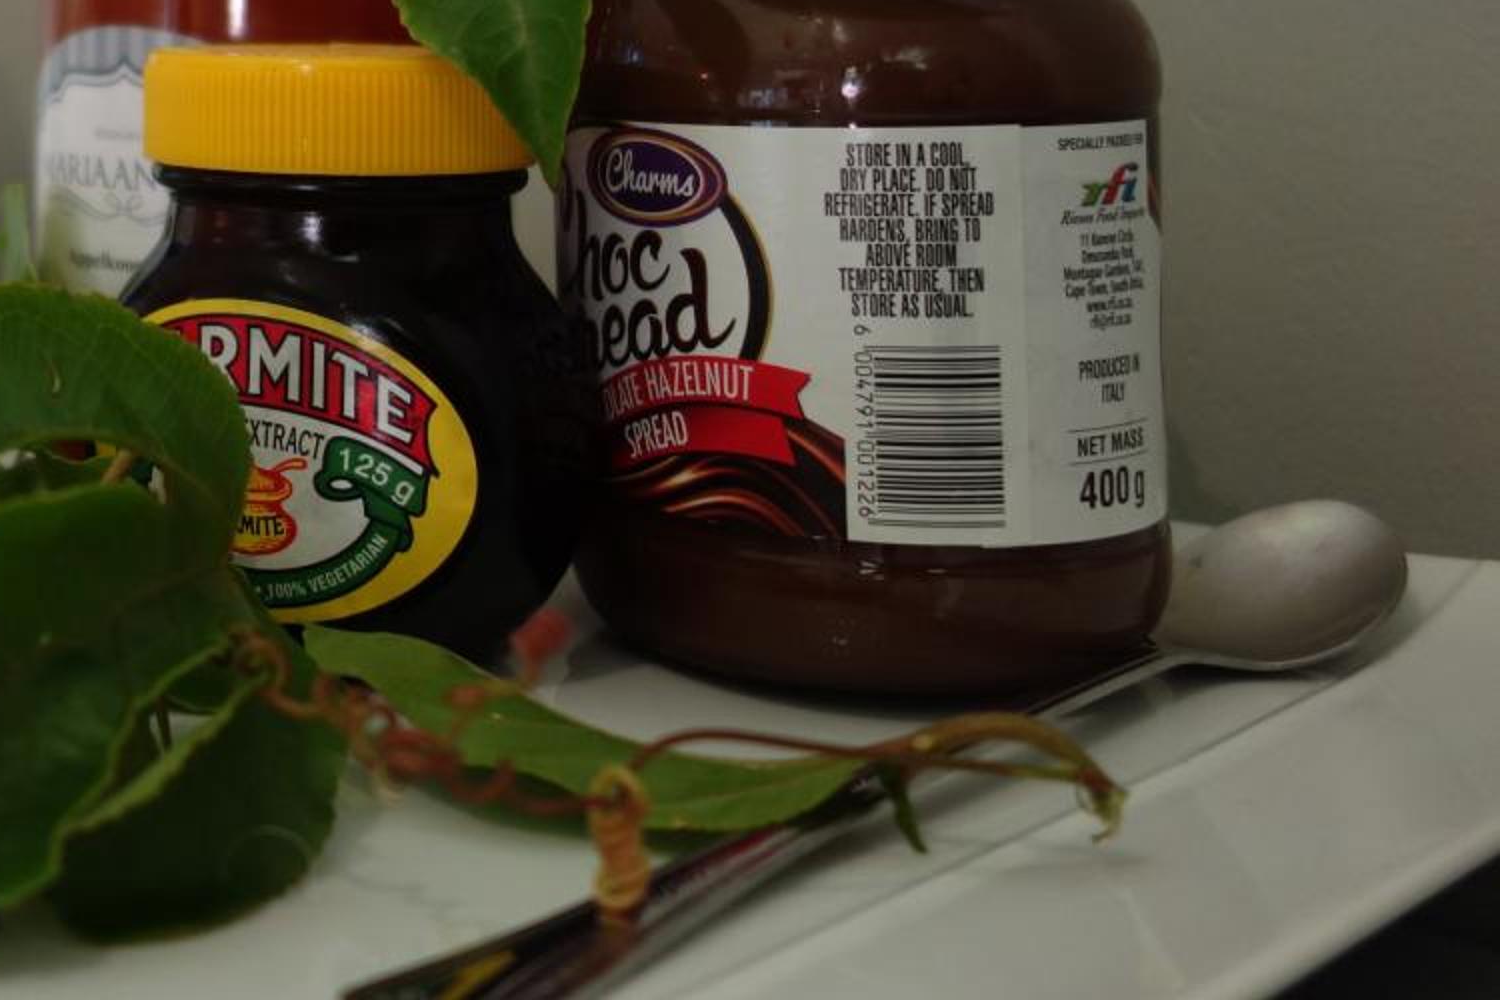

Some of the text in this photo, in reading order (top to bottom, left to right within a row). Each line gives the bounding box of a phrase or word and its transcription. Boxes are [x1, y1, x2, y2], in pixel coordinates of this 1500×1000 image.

[845, 143, 891, 167] STORE
[896, 143, 911, 167] IN
[916, 143, 926, 167] A
[605, 148, 695, 197] Charms
[840, 168, 977, 192] DRY PLACE. DO NOT
[824, 192, 995, 217] REFRIGERATE. IF SPREAD
[916, 218, 959, 242] BRING
[964, 218, 981, 242] TO
[866, 244, 957, 267] ABOVE ROOM
[948, 268, 985, 292] THEN
[851, 293, 974, 318] STORE AS USUAL.
[643, 361, 754, 401] HAZELNUT
[1078, 354, 1130, 382] PRODUCED
[198, 324, 414, 443] RMITE
[1102, 382, 1125, 403] ITALY
[854, 324, 876, 518] 6 004791 001226
[624, 411, 689, 459] SPREAD
[1077, 426, 1144, 457] NET MASS
[339, 448, 393, 487] 125
[237, 516, 285, 537] MITE
[267, 532, 389, 600] 100% VEGETARIAN
